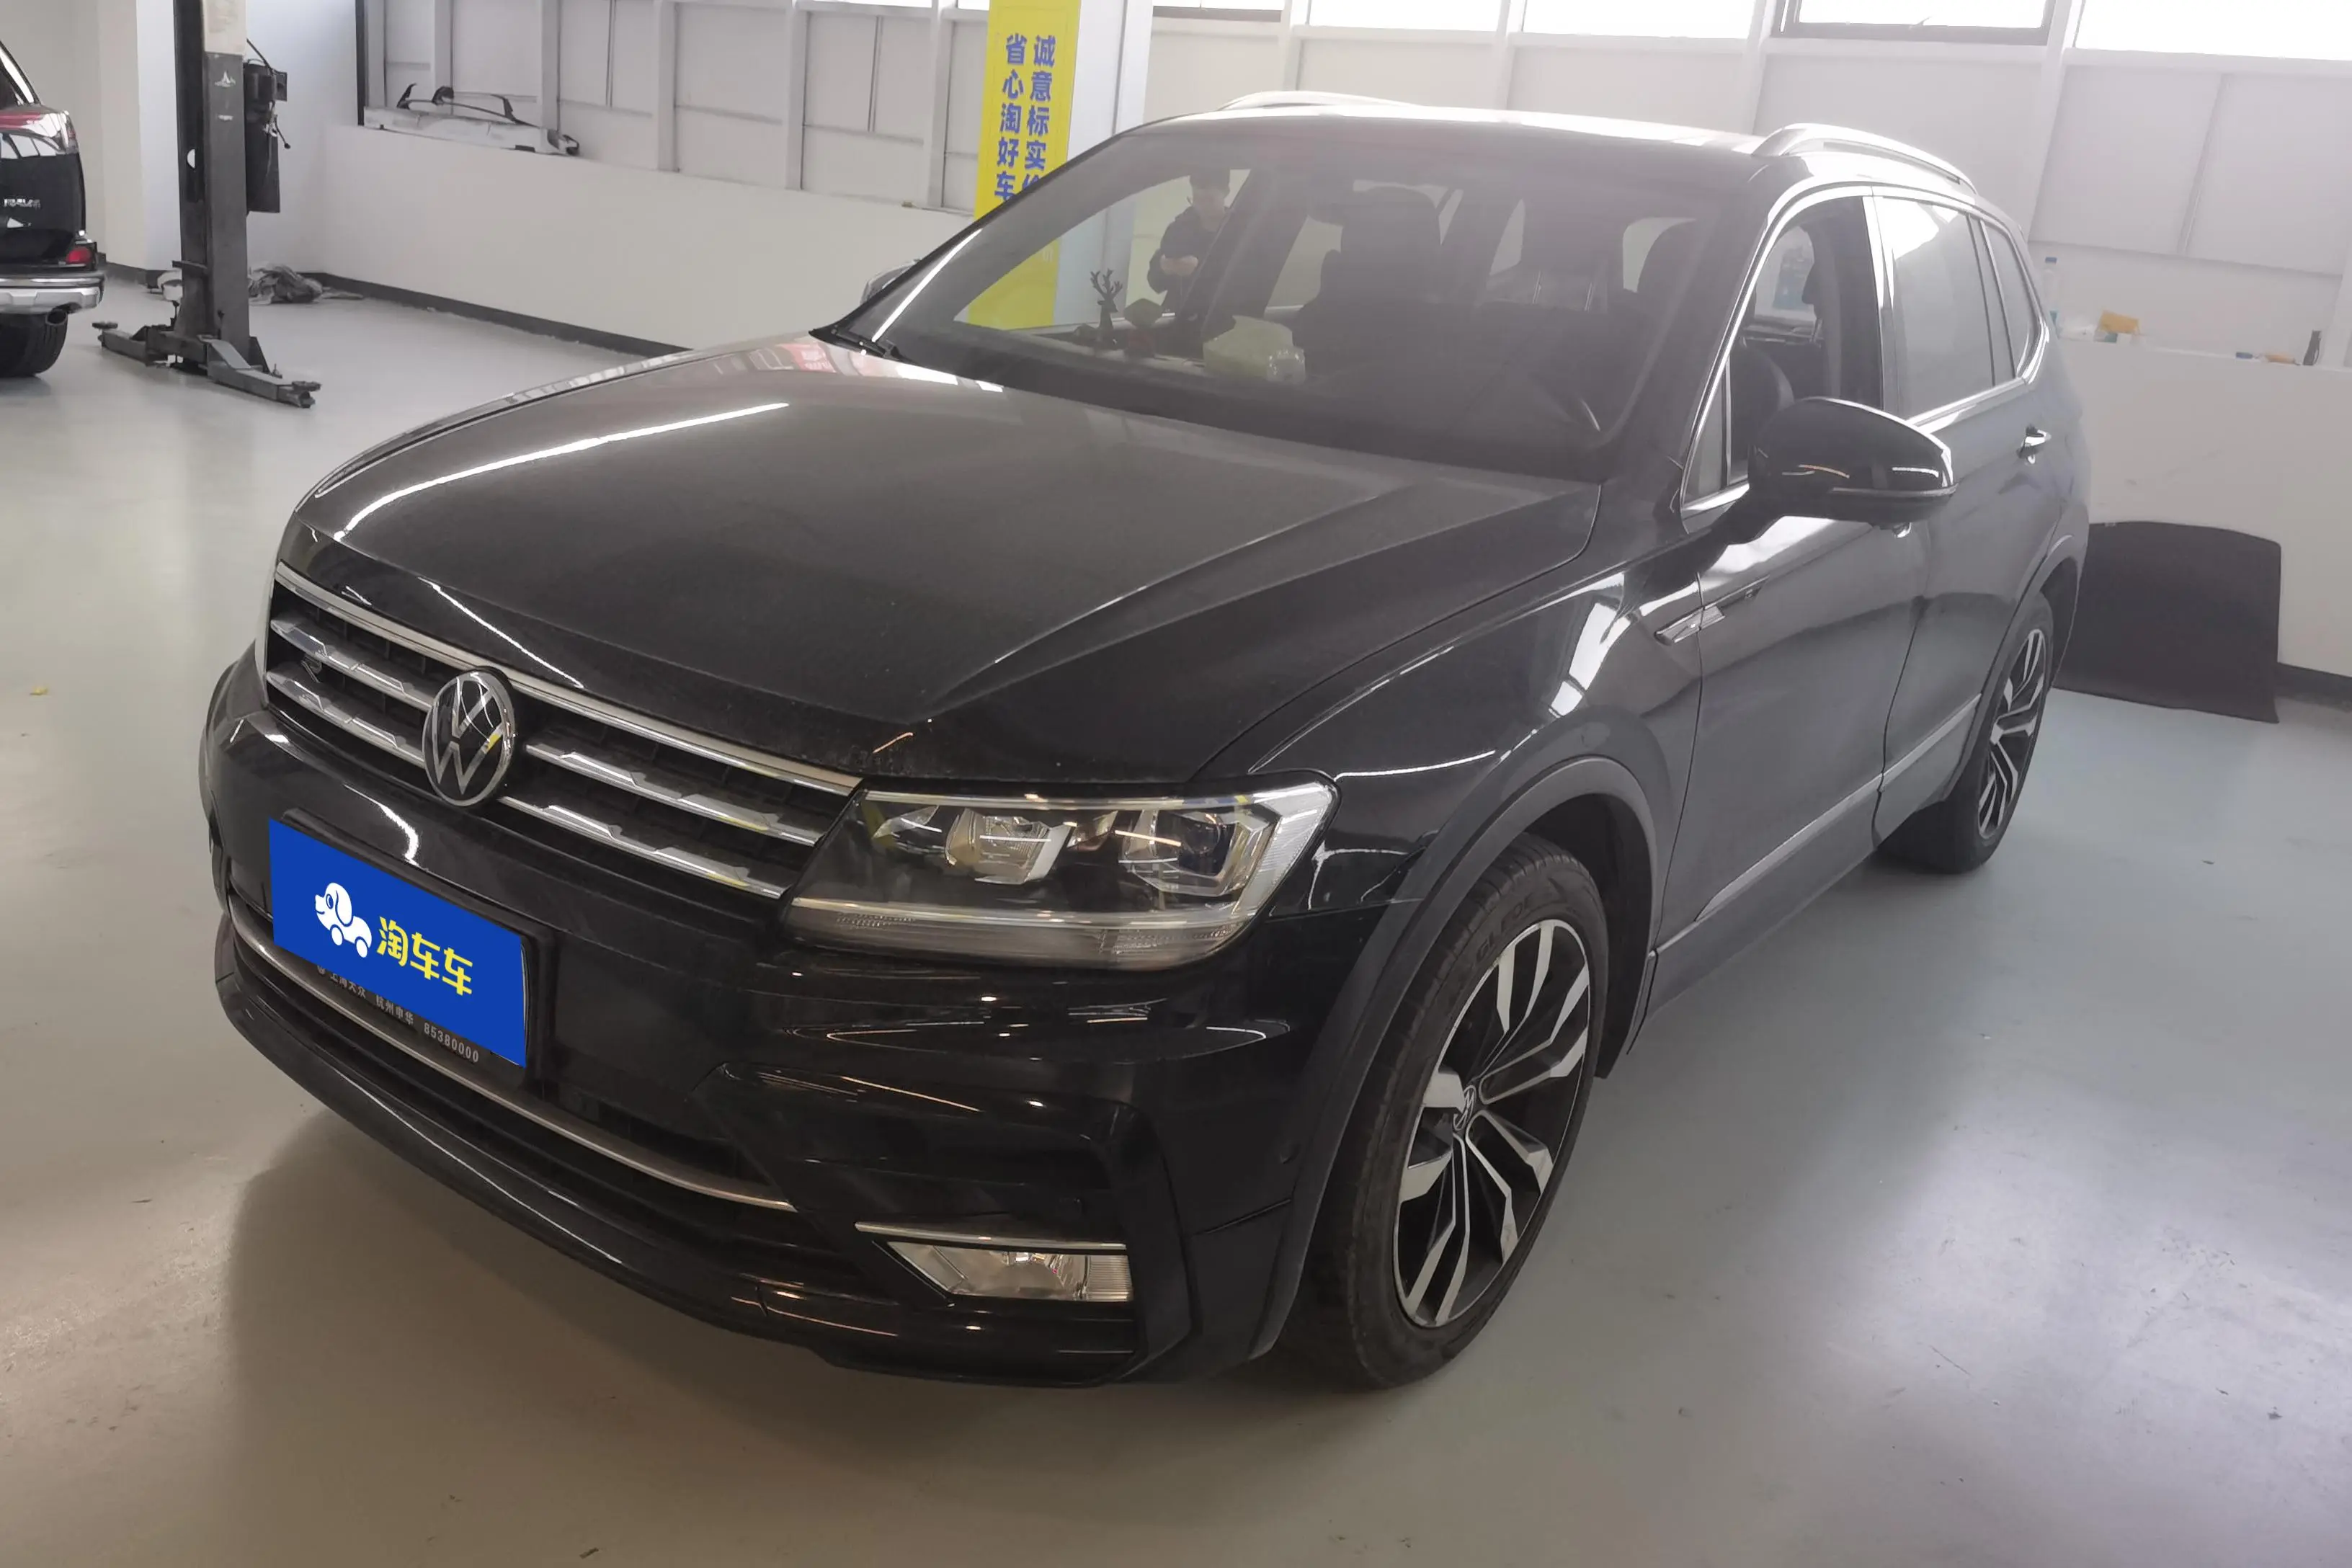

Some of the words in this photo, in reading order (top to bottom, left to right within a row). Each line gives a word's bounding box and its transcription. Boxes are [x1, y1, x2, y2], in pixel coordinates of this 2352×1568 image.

[994, 33, 1027, 201] 省心淘好车
[424, 1022, 479, 1063] 85380000
